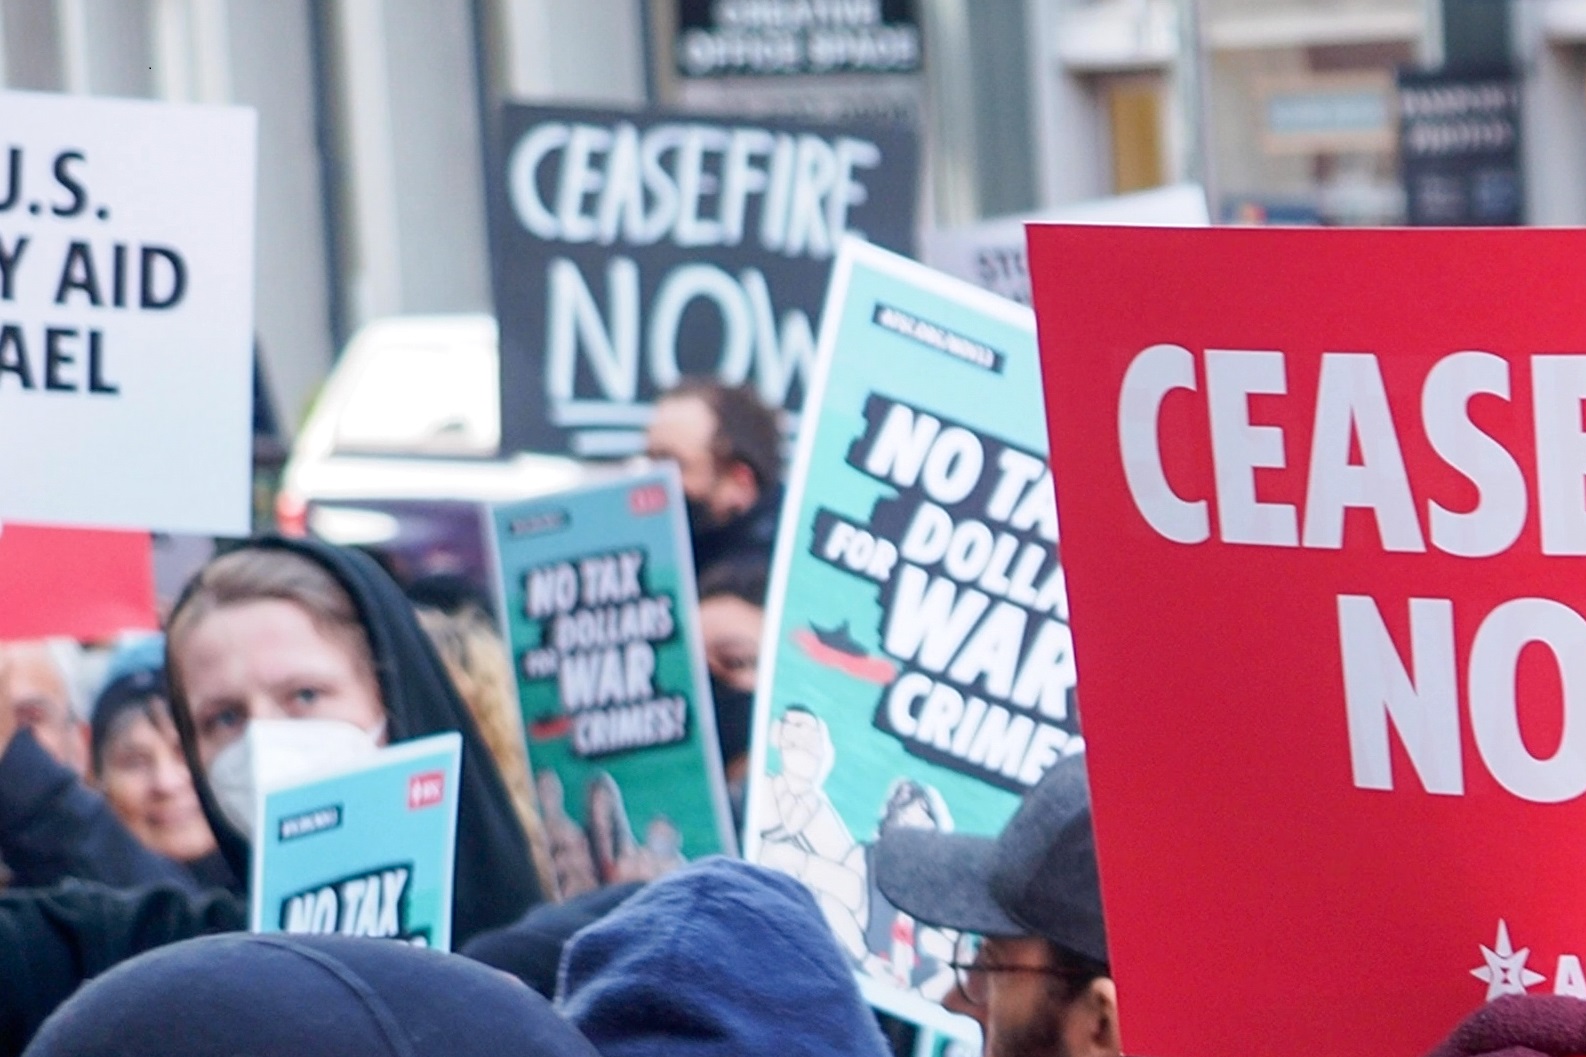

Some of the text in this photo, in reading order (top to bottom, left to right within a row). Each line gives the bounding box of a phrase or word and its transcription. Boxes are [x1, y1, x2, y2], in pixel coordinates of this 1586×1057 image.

[508, 120, 882, 260] CEASEFIRE
[54, 240, 188, 310] AID
[546, 256, 822, 405] NOW
[864, 403, 984, 504] NO
[526, 549, 643, 620] NO TAX
[824, 521, 898, 582] FOR
[560, 640, 656, 713] WAR
[884, 563, 1078, 722] WAR
[289, 868, 408, 938] NO TAX
